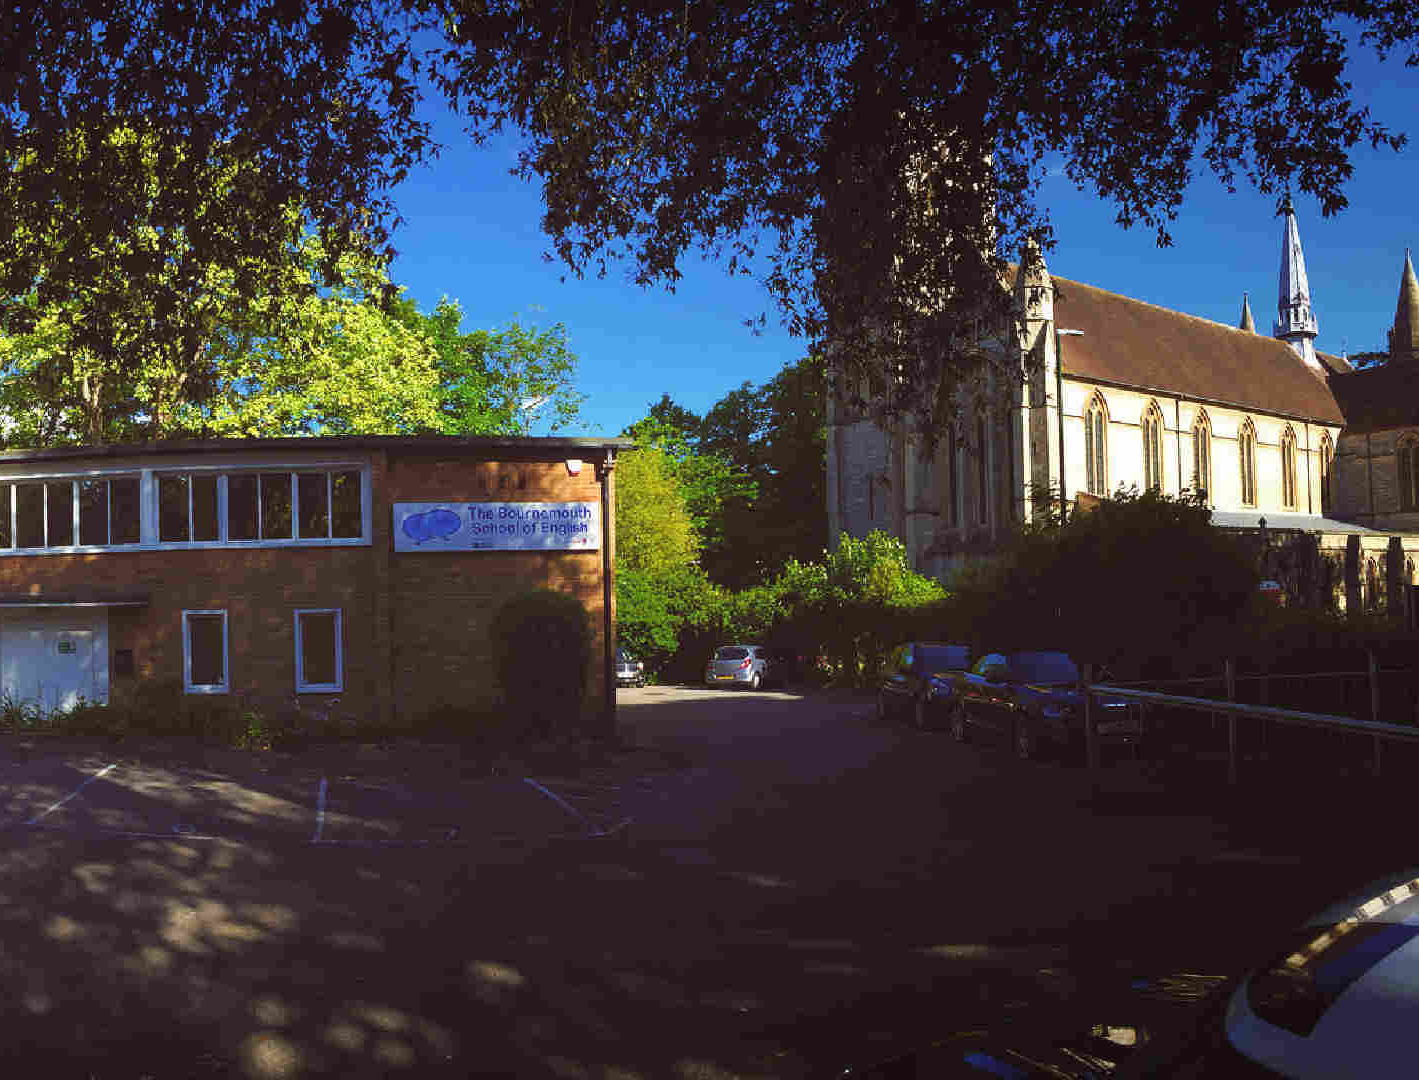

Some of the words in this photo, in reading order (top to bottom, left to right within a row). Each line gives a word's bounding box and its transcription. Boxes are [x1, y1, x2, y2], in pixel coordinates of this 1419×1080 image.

[468, 506, 494, 521] The
[498, 506, 592, 521] Bournemouth
[473, 522, 519, 536] School
[523, 522, 537, 535] of
[541, 522, 588, 537] English
